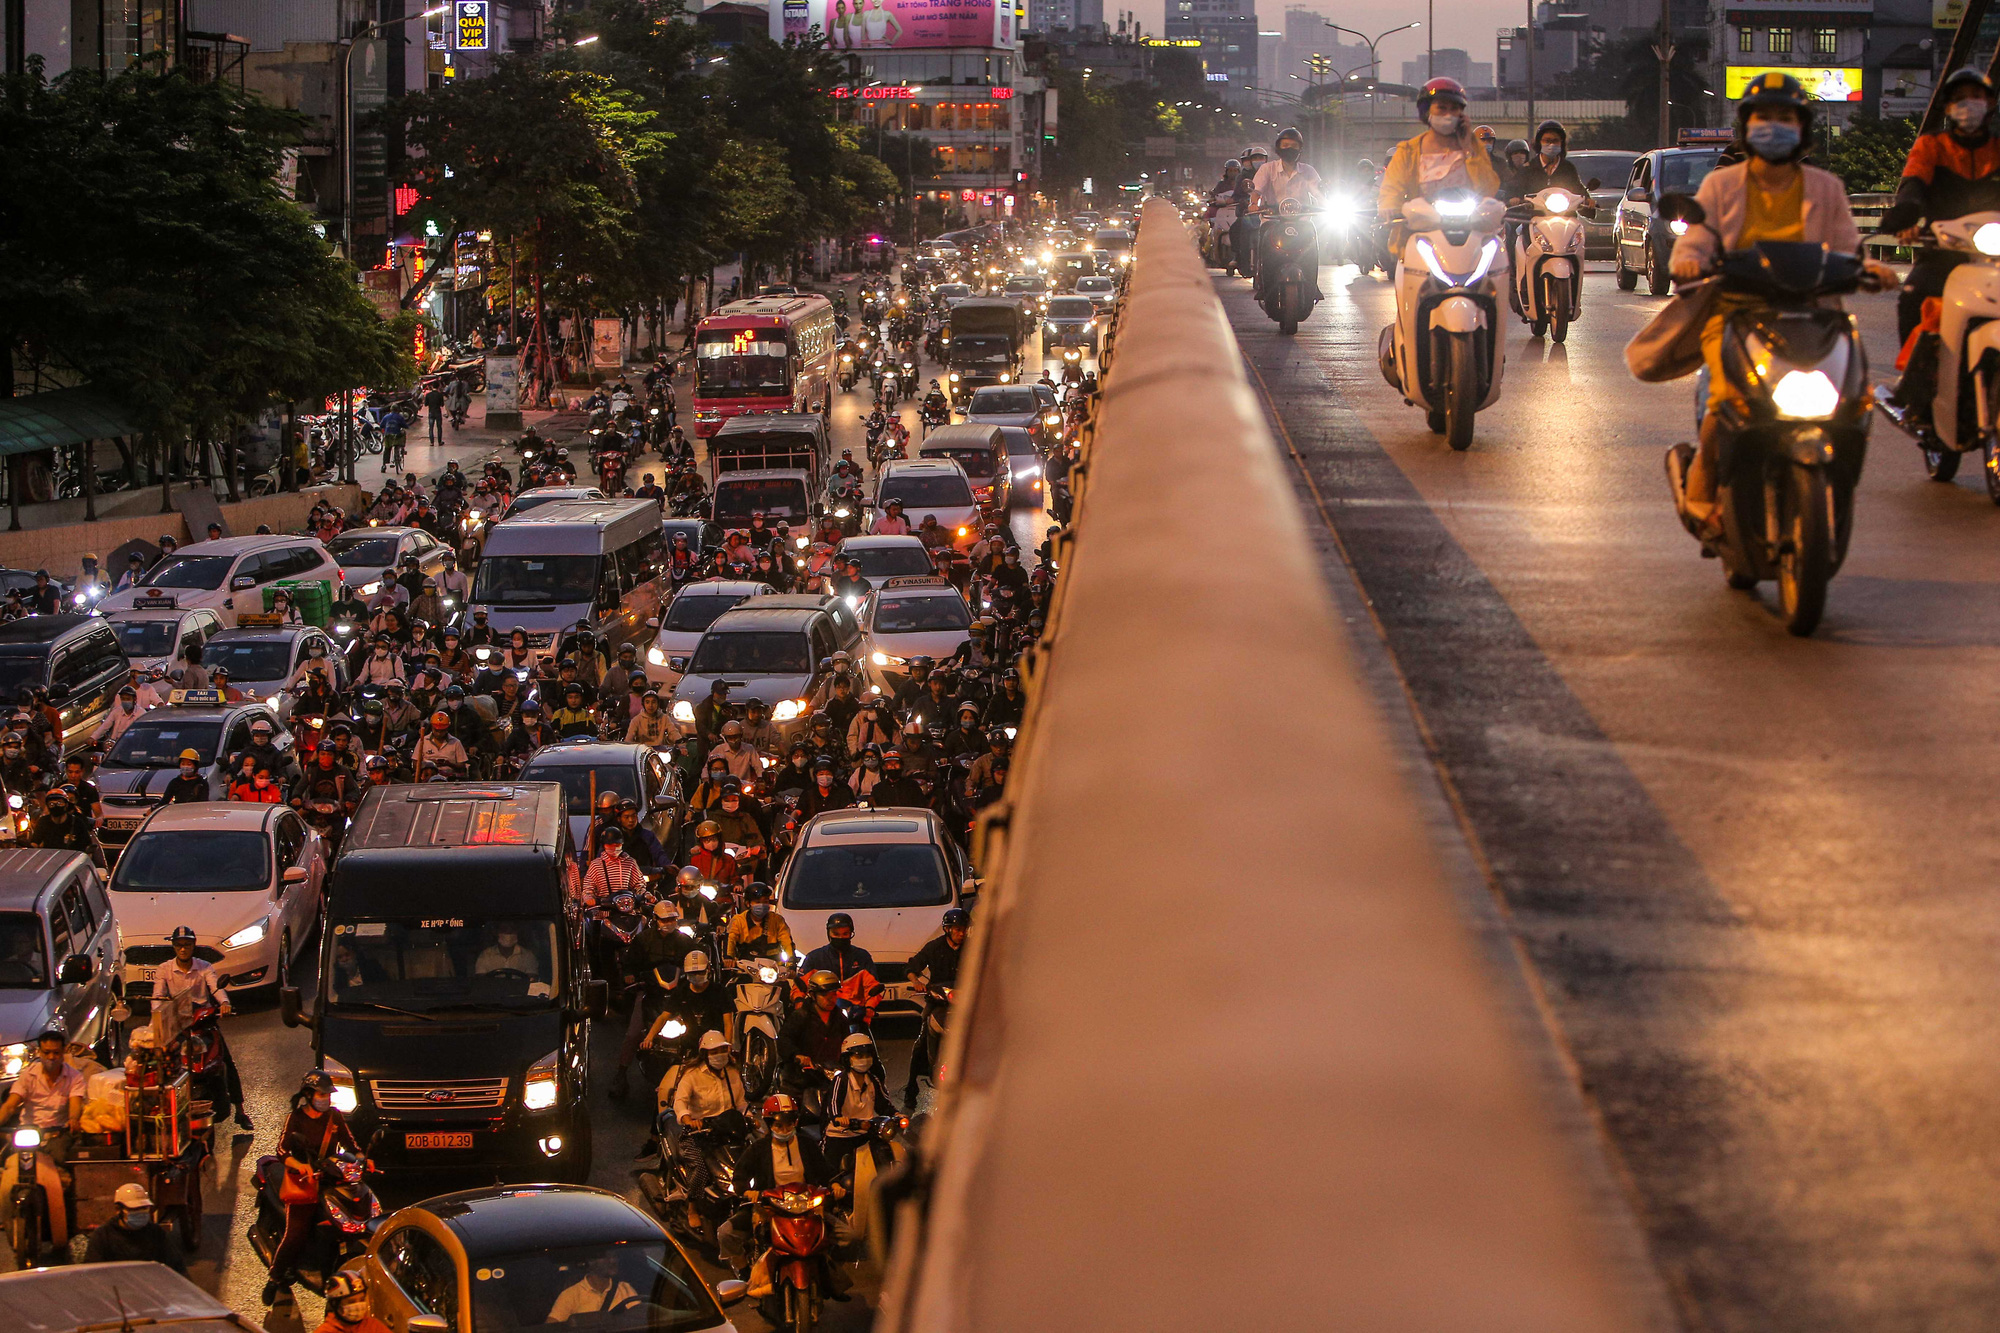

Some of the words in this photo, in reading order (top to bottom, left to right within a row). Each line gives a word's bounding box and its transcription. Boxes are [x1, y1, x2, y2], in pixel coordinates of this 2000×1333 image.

[459, 16, 485, 27] QUÀ
[462, 29, 482, 38] VIP
[461, 38, 483, 47] 24K
[962, 190, 976, 201] 93
[421, 920, 430, 928] XE
